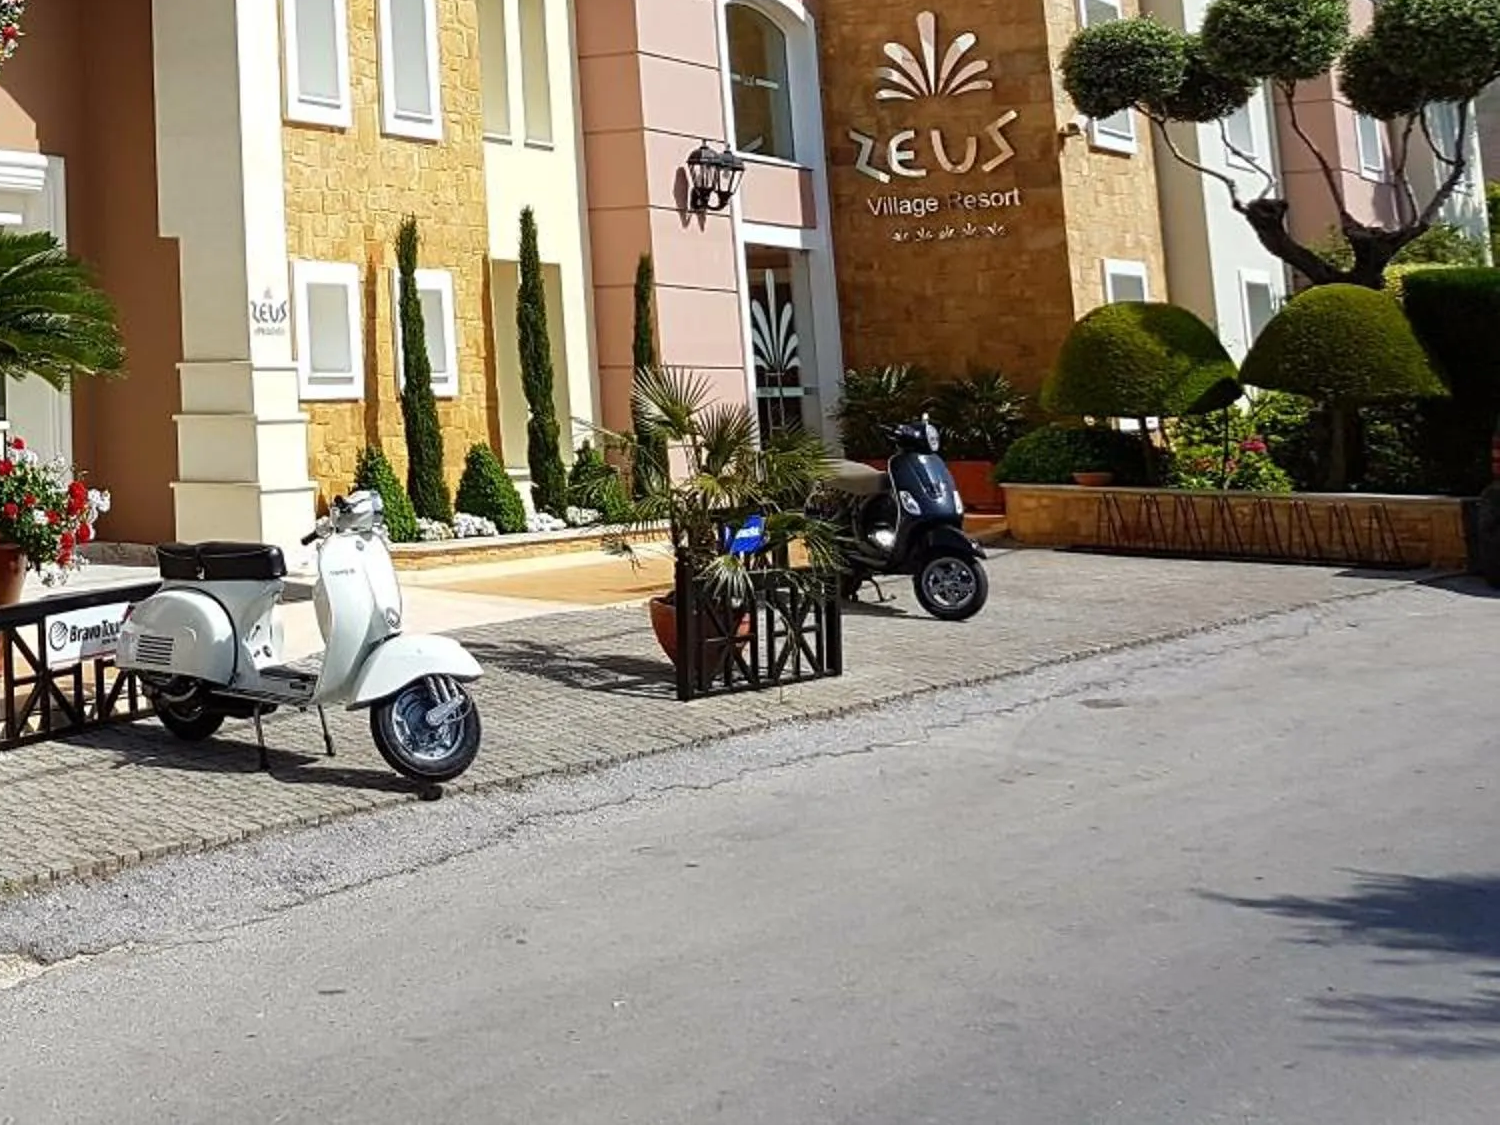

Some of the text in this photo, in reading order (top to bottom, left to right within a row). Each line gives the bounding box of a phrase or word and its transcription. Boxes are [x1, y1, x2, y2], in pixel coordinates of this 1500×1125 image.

[849, 110, 1017, 183] ZEUS
[867, 187, 1021, 217] Village Resort
[250, 300, 287, 324] ZEUS
